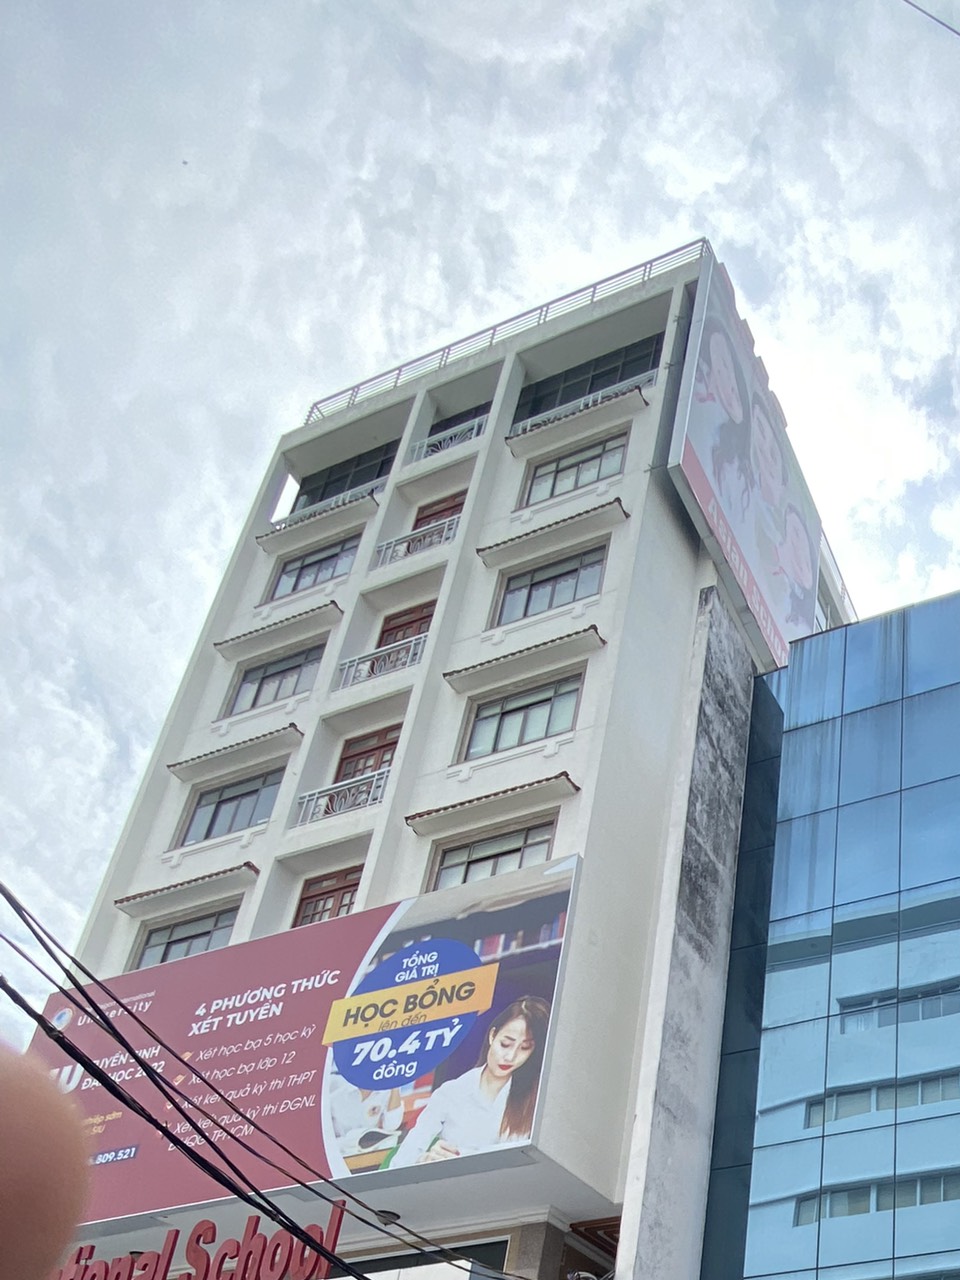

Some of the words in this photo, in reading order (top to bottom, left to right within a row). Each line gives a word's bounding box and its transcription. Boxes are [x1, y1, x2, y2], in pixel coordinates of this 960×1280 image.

[402, 951, 438, 969] TỔNG
[395, 967, 418, 983] GIÁ
[421, 964, 439, 978] TRỊ
[194, 1003, 207, 1016] 4
[210, 984, 286, 1014] PHƯƠNG
[291, 970, 340, 994] THỨC
[343, 1000, 398, 1027] HỌC
[403, 979, 475, 1013] BỔNG
[188, 1016, 222, 1036] XÉT
[226, 1001, 283, 1027] TUYỂN
[401, 1012, 427, 1027] đến
[195, 1048, 218, 1062] Xét
[217, 1042, 243, 1057] học
[244, 1038, 261, 1051] bạ
[264, 1033, 273, 1046] 5
[273, 1030, 299, 1045] học
[352, 1030, 421, 1066] 70.4
[425, 1018, 462, 1050] TỶ
[210, 1066, 236, 1081] học
[237, 1060, 255, 1073] bạ
[281, 1050, 296, 1065] 12
[373, 1060, 417, 1080] đồng
[269, 1078, 283, 1091] thi
[286, 1070, 317, 1088] THPT
[262, 1102, 279, 1116] thi
[279, 1094, 316, 1112] ĐGNL
